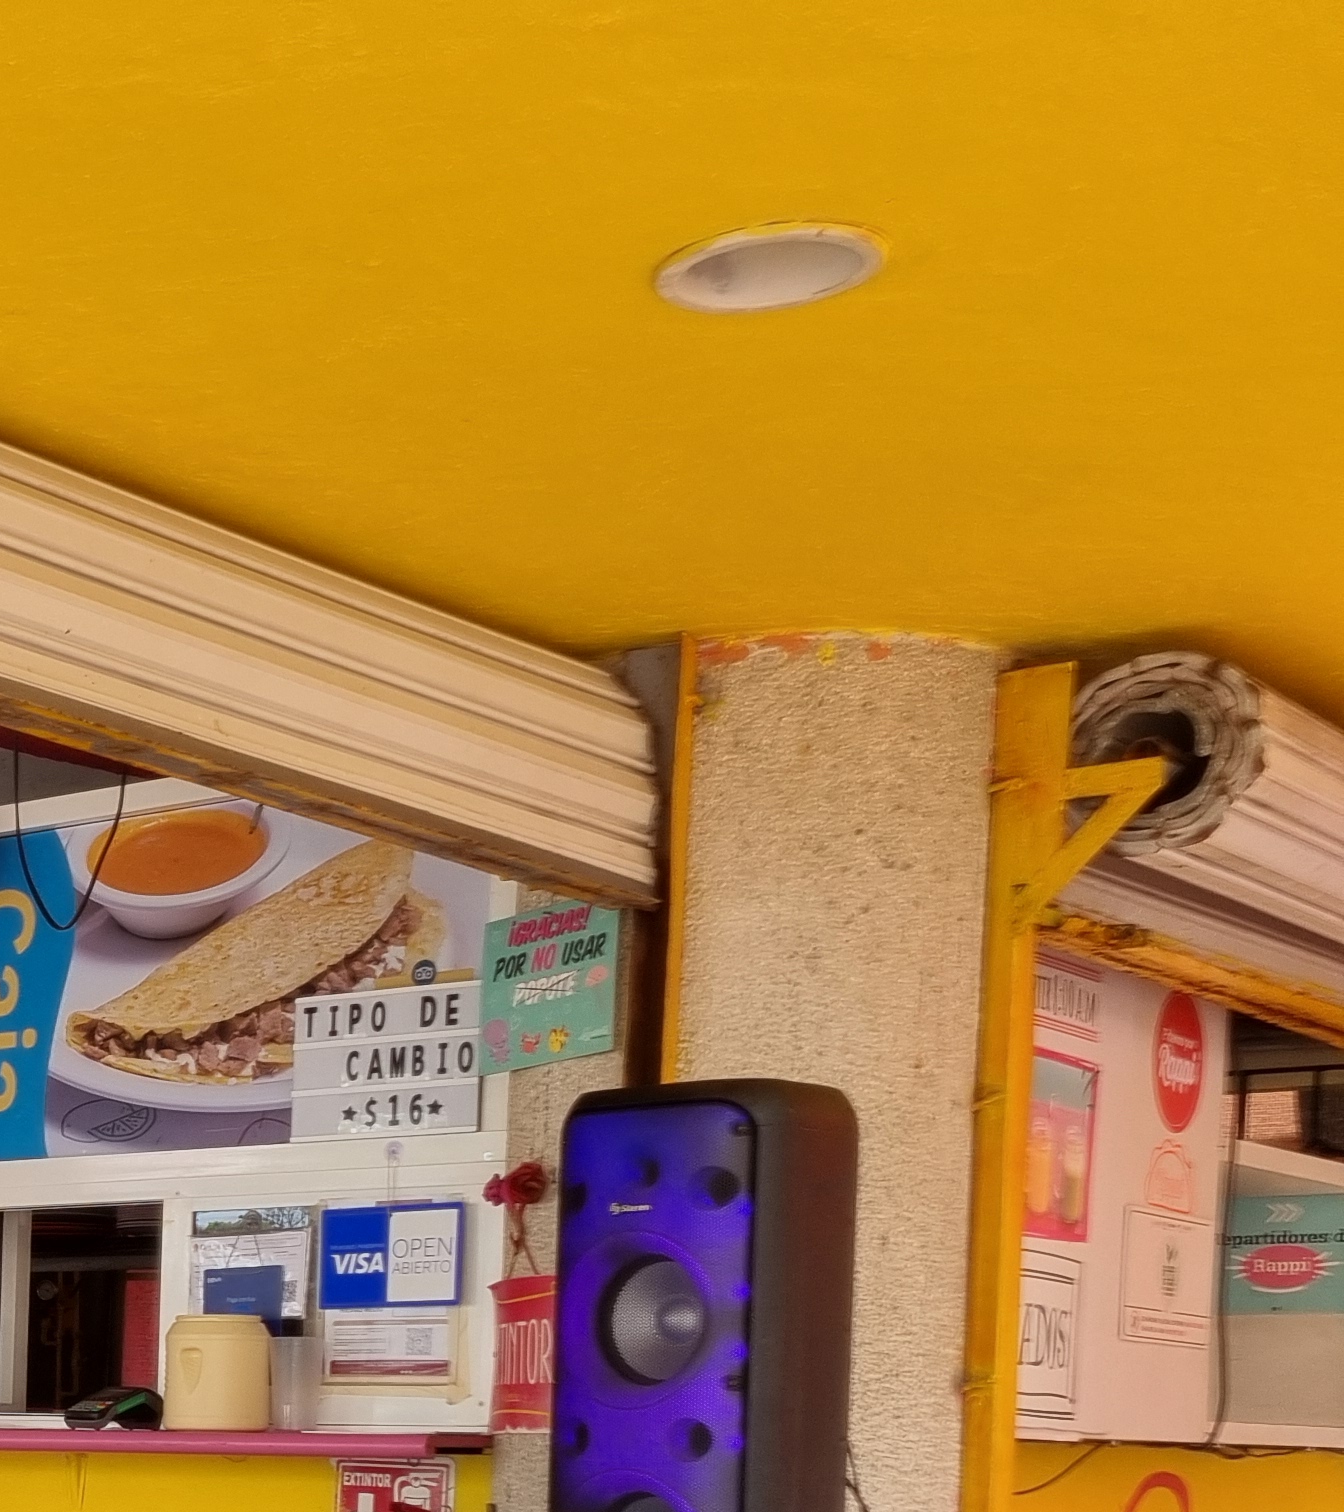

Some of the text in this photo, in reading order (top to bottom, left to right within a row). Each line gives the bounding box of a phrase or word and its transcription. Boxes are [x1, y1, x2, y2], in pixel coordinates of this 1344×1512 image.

[507, 904, 592, 947] ¡GRACIAS!
[493, 932, 607, 982] POR NO USAR
[304, 993, 459, 1038] TIPO DE
[346, 1041, 474, 1081] CAMBIO
[330, 1252, 385, 1274] VISA
[392, 1237, 453, 1259] OPEN
[392, 1260, 452, 1274] ABIERTO
[343, 1472, 391, 1488] EXTINTOR
